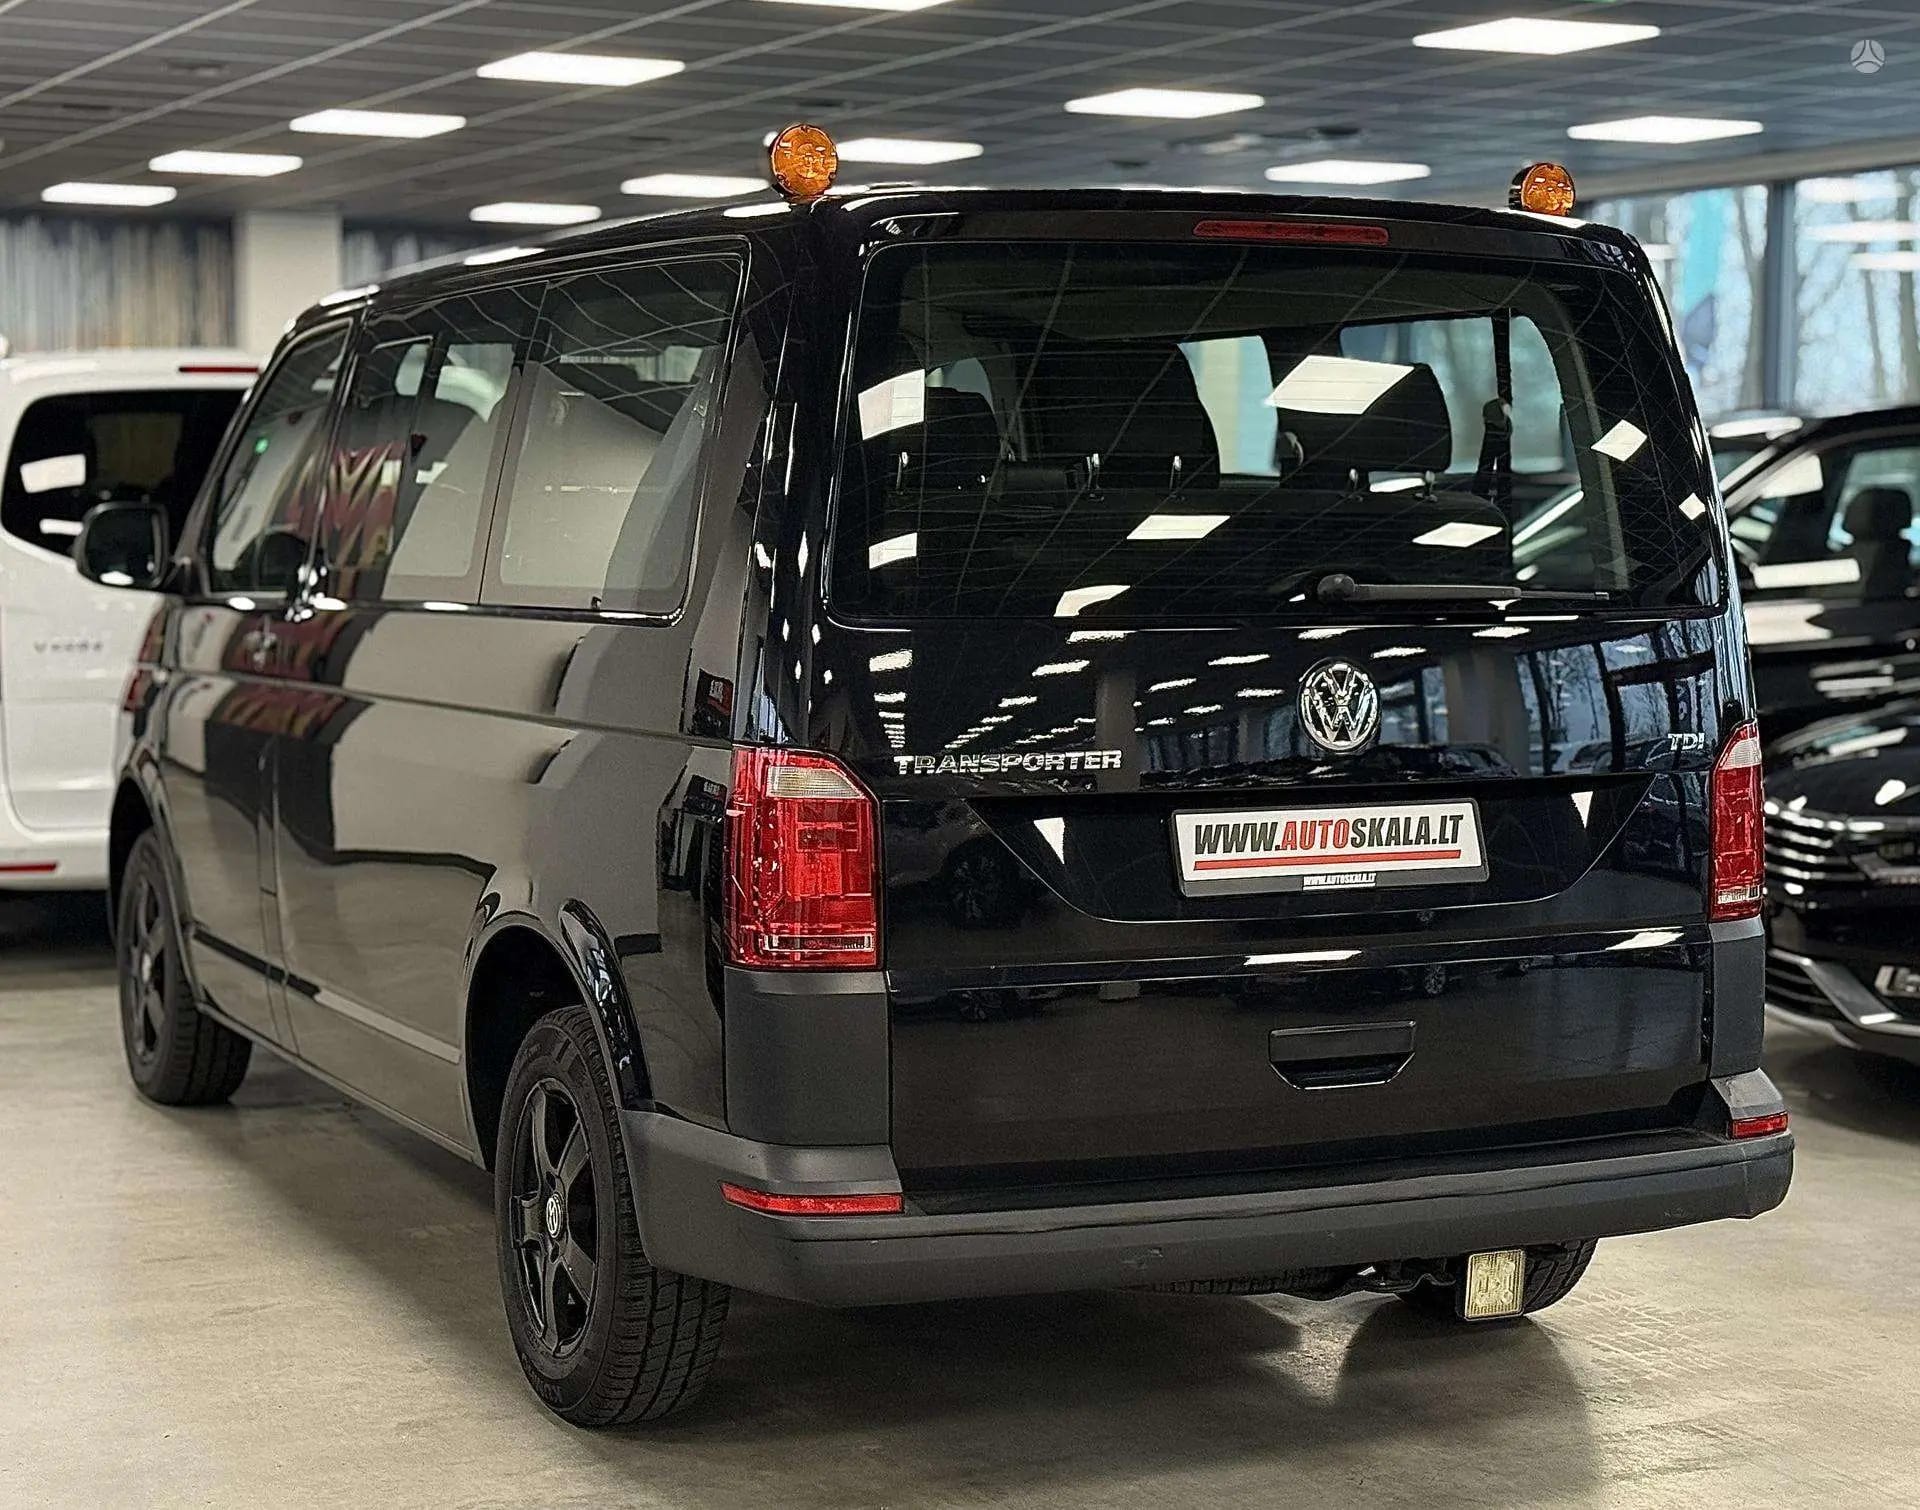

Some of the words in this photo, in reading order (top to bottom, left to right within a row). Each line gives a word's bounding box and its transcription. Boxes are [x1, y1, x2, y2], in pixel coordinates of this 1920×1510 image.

[1668, 732, 1705, 750] TDI
[893, 750, 1122, 774] TRANSPORTER
[1194, 814, 1464, 855] WWW.AUTOSKALA.LT
